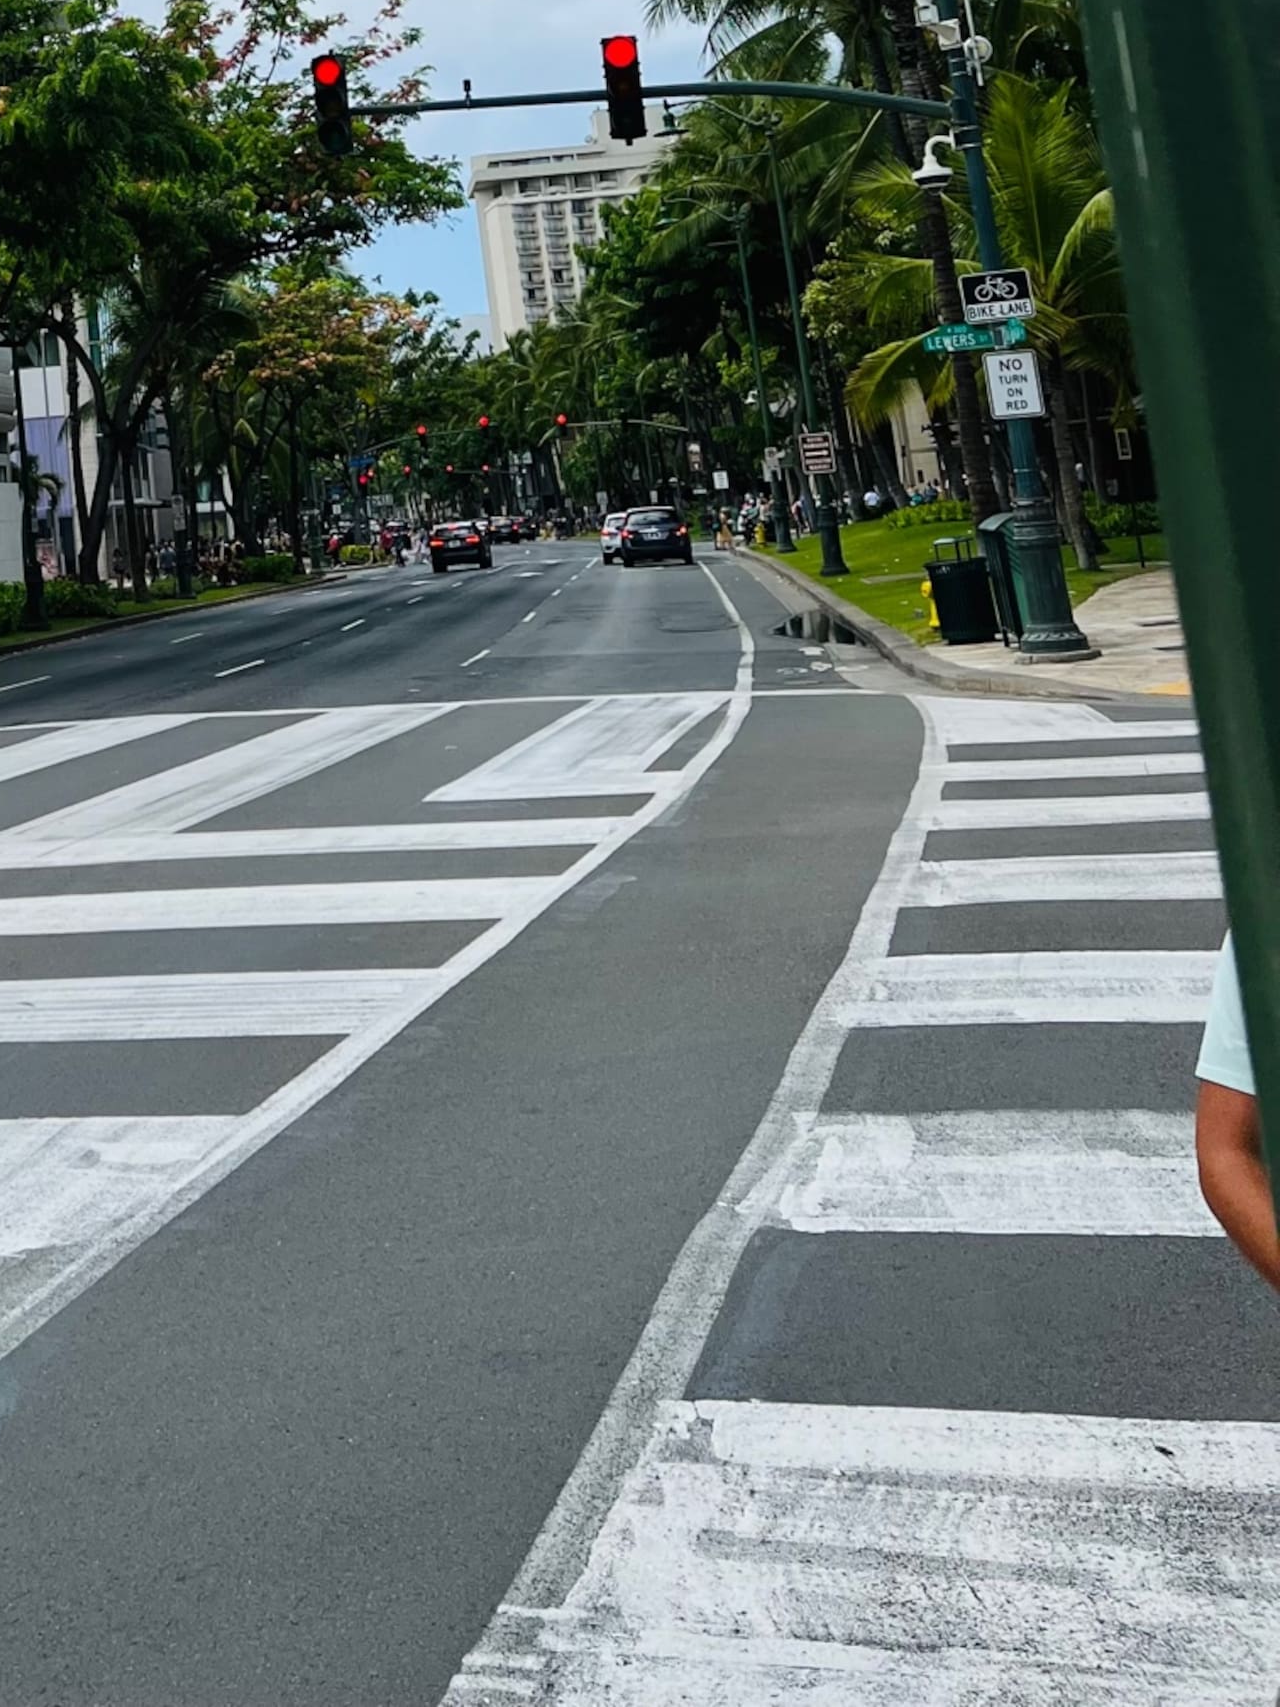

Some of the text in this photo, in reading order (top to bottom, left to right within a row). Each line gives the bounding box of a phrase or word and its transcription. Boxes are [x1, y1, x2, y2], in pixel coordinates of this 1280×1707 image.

[968, 301, 1030, 319] BIKE LANE
[927, 334, 976, 350] LEWERS
[999, 358, 1023, 371] NO
[999, 374, 1028, 384] TURN
[1007, 387, 1023, 397] ON
[1006, 400, 1028, 410] RED
